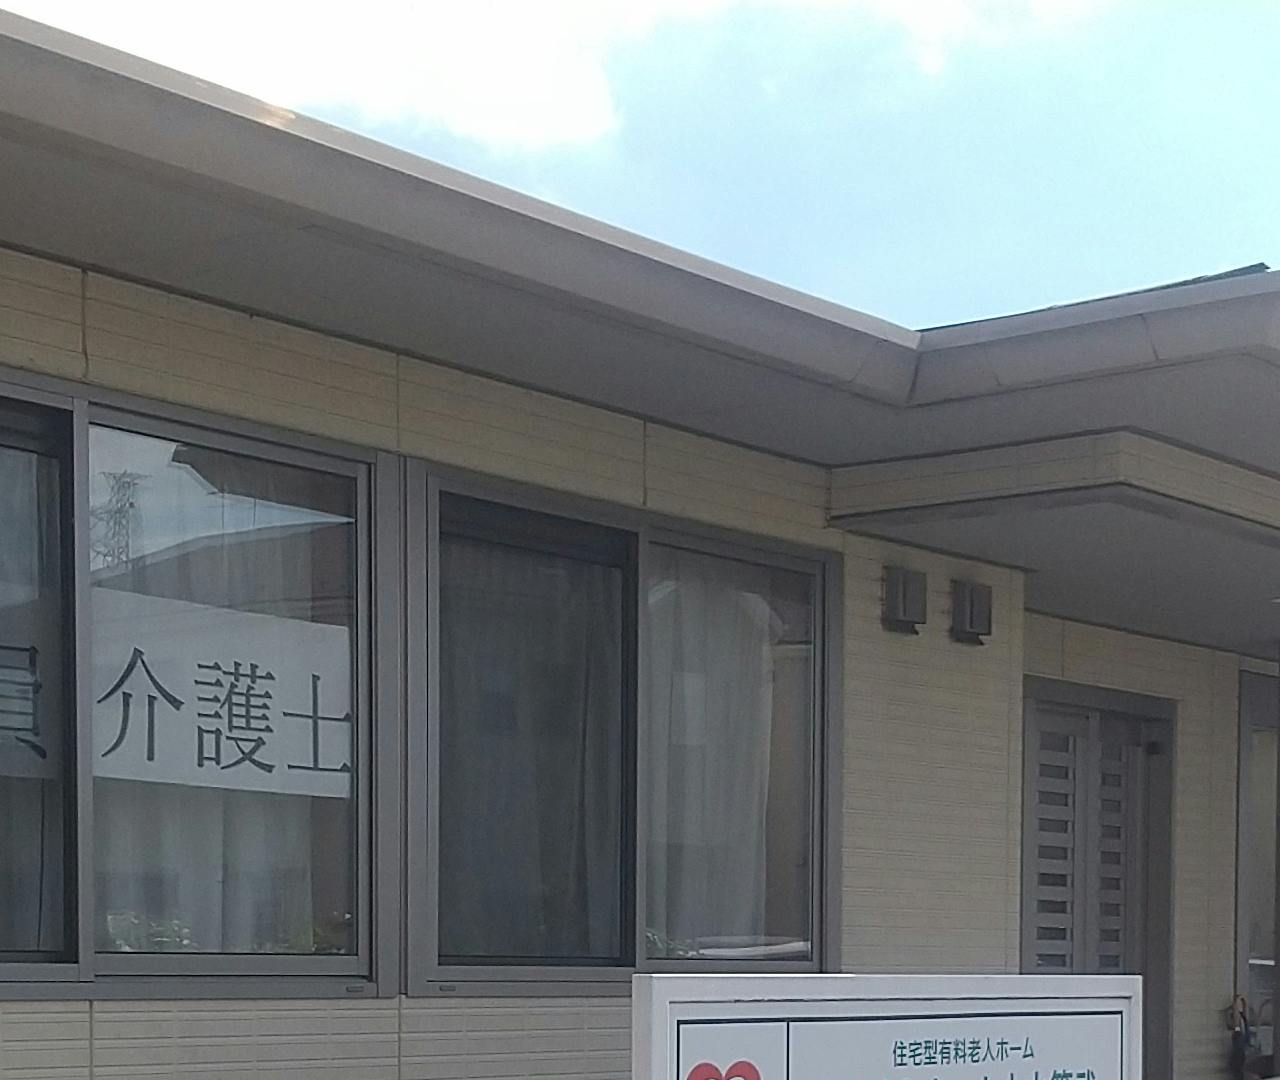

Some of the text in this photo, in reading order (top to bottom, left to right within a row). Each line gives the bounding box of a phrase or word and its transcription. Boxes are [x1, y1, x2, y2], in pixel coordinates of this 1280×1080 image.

[97, 647, 352, 774] 介護士
[892, 1037, 1035, 1067] 住宅型有料老人ホーム
